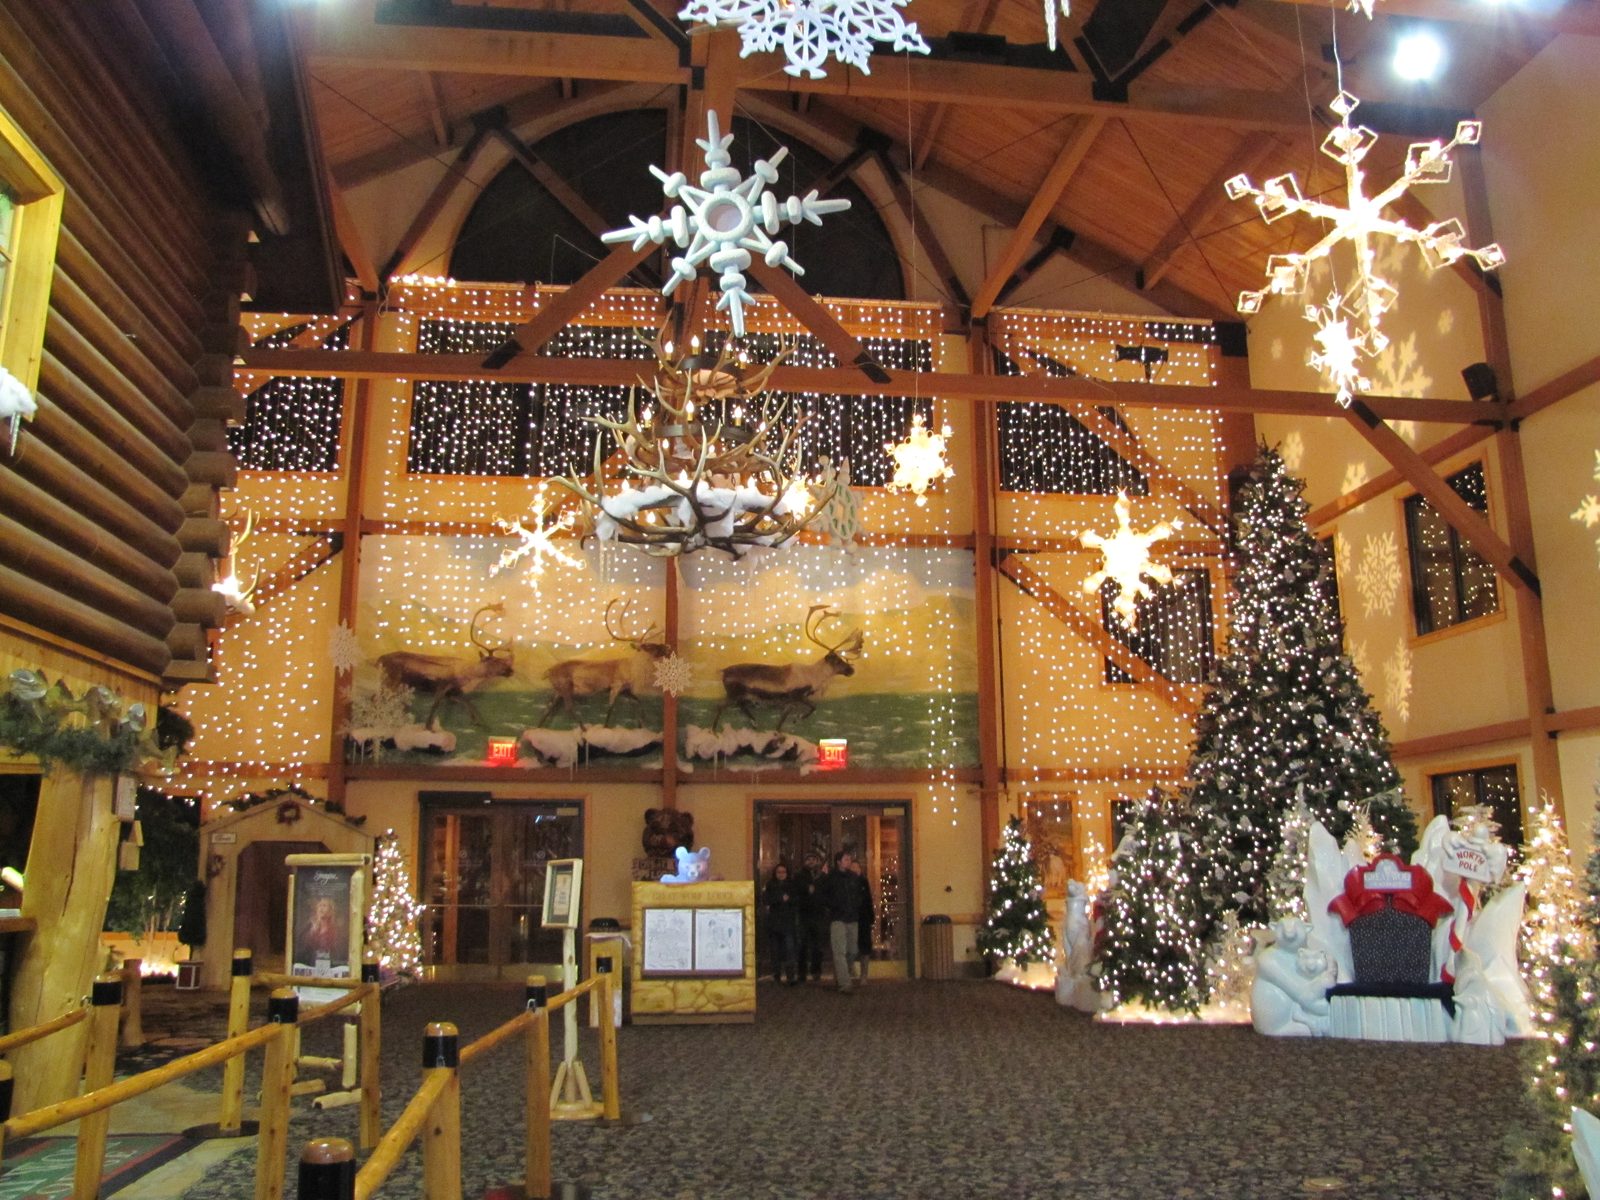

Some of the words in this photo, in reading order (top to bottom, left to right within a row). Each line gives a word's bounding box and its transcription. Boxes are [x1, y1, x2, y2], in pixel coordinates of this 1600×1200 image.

[493, 743, 513, 757] EXIT
[824, 746, 845, 760] EXIT
[1456, 850, 1486, 865] NORTH
[1458, 860, 1479, 872] POLE
